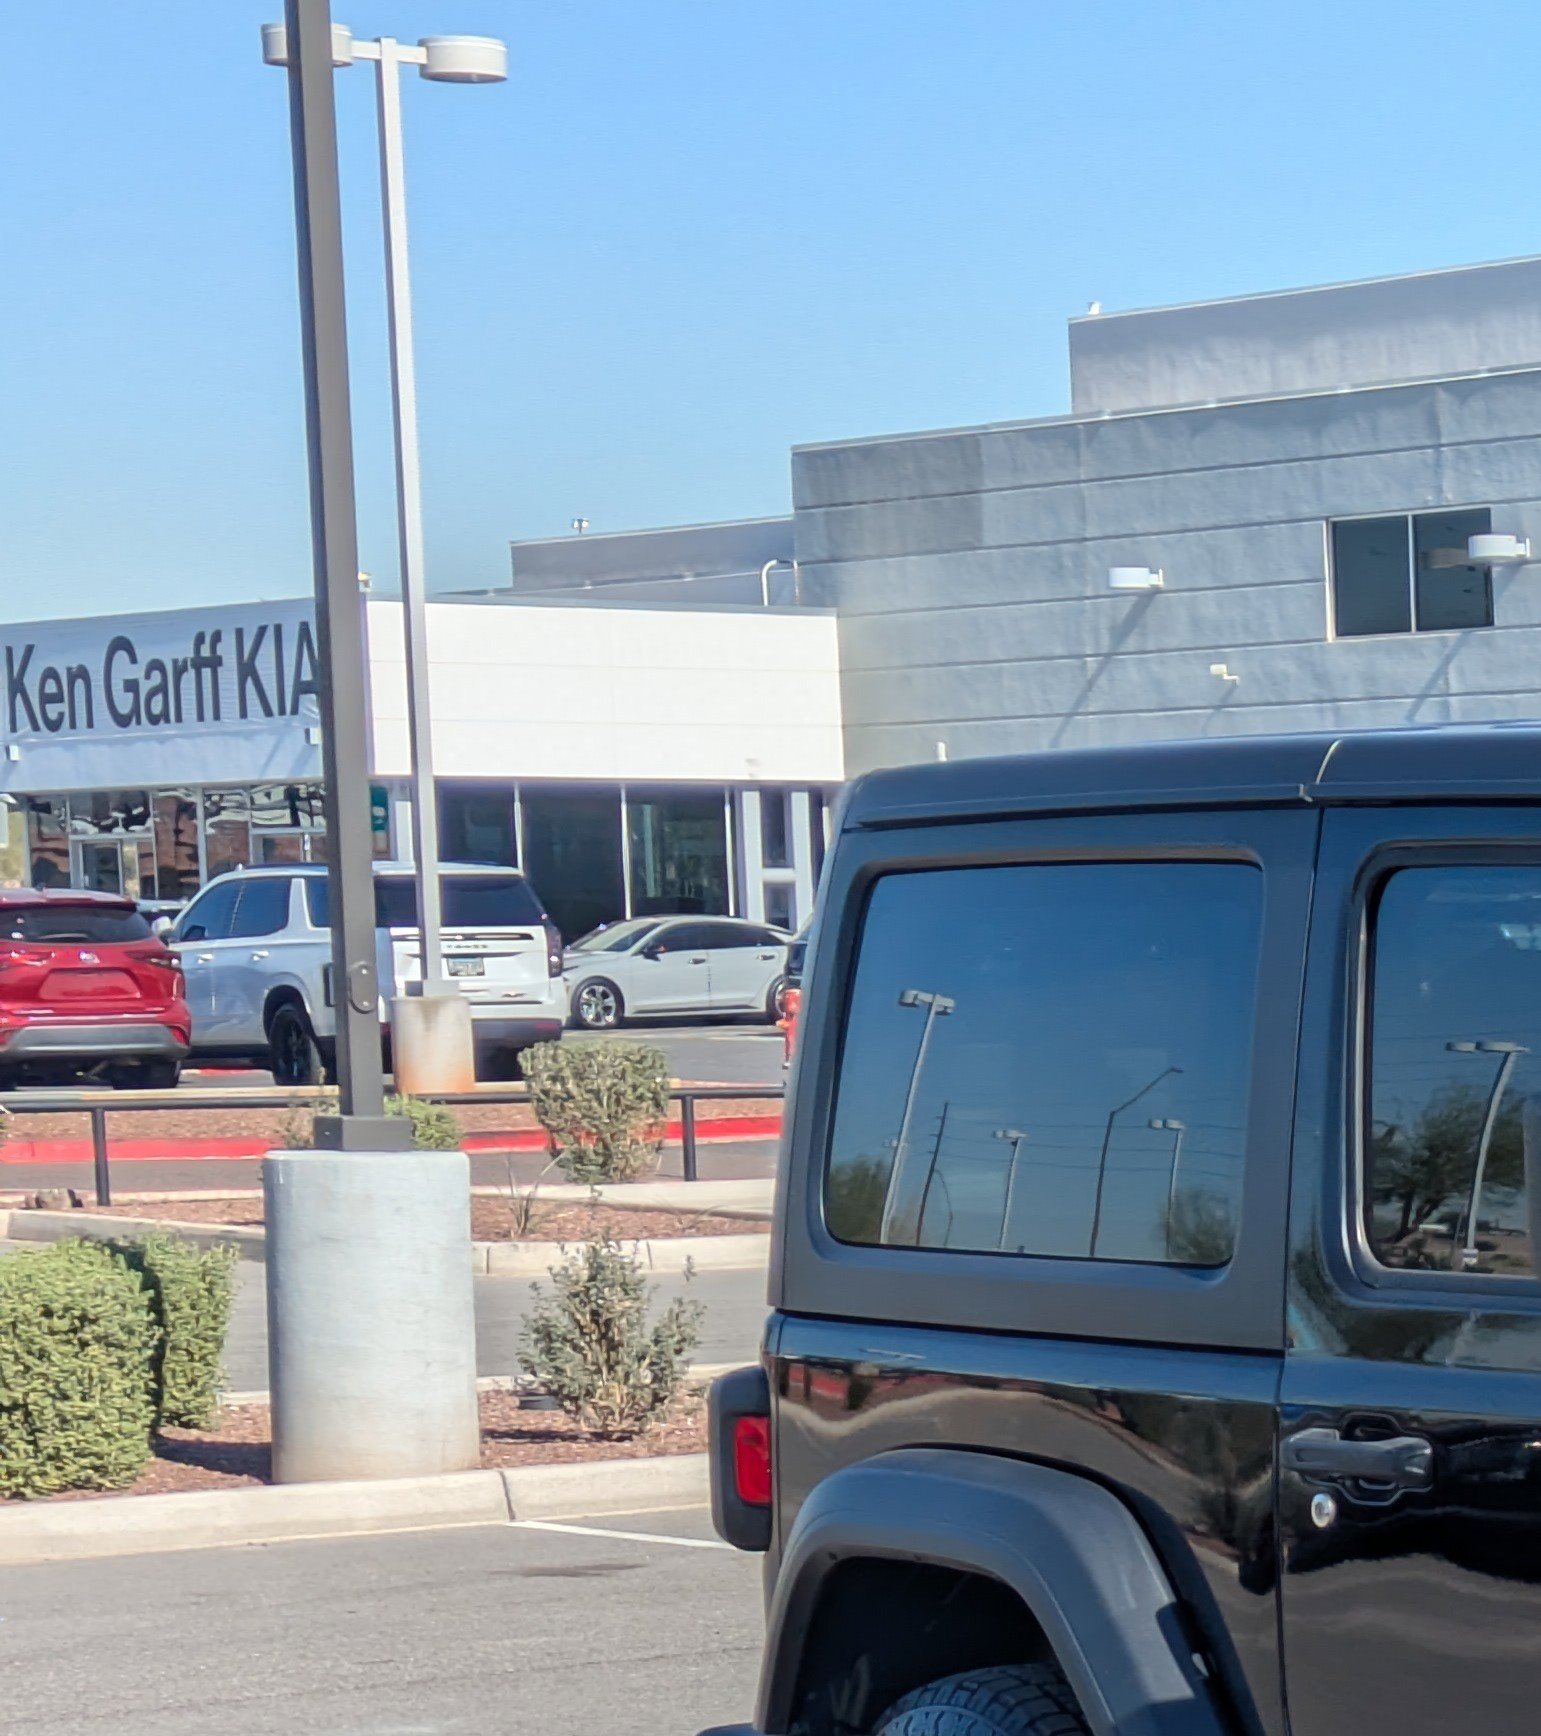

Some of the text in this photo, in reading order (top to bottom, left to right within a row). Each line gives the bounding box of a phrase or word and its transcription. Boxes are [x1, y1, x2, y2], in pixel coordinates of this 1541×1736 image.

[6, 621, 320, 733] Ken Garff KIA
